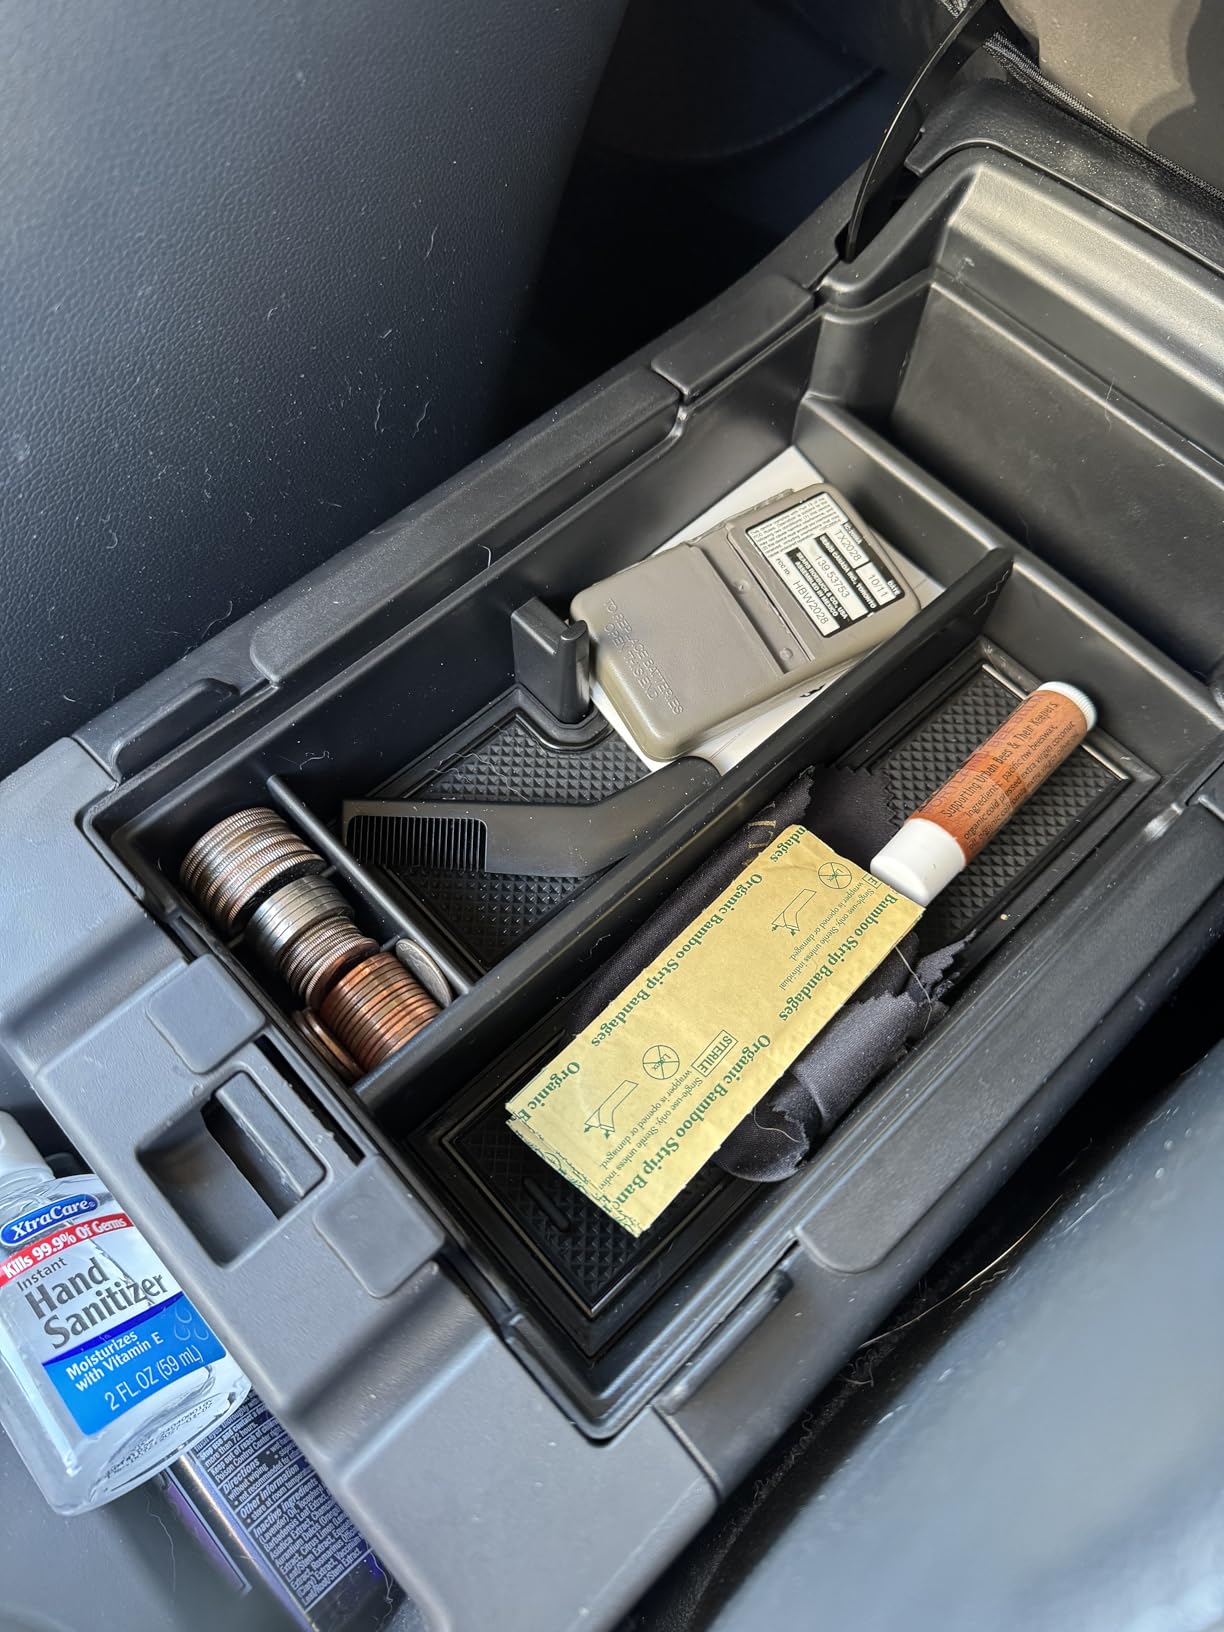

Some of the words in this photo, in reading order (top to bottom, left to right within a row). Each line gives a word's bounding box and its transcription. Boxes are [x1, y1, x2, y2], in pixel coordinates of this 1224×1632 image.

[834, 529, 861, 561] TX2028
[794, 561, 819, 590] ASSEMBLED
[816, 589, 824, 597] IN
[820, 595, 838, 616] MEXICO
[796, 551, 811, 569] SEARS
[808, 567, 828, 593] ROEBUCK
[837, 606, 847, 619] USA
[815, 555, 850, 597] 139.53753
[819, 535, 834, 552] SEARS
[831, 551, 850, 572] CANADA
[855, 582, 876, 608] TORONTO
[868, 574, 888, 597] 10/11
[886, 580, 900, 595] DATE
[792, 580, 829, 624] HBW2028
[602, 622, 629, 651] OPEN
[635, 674, 661, 701] END
[609, 610, 650, 661] REPLACE
[641, 656, 686, 717] BATTERIES
[940, 781, 982, 821] Supporting
[974, 762, 999, 782] Urban
[992, 748, 1013, 764] Bees
[1006, 740, 1020, 749] &
[1013, 724, 1034, 741] Their
[1029, 701, 1058, 726] Keepers
[963, 813, 987, 842] organic
[985, 798, 1000, 816] cold
[998, 775, 1023, 804] pressed
[1020, 762, 1037, 779] extra
[1035, 744, 1055, 763] virgin
[1051, 720, 1075, 746] coconut
[1001, 758, 1023, 782] pacific
[718, 871, 762, 916] Organic
[842, 881, 863, 903] wrapper
[846, 888, 874, 914] Single-use
[675, 913, 723, 961] Bamboo
[819, 907, 839, 929] opened
[819, 926, 839, 944] Sterile
[835, 913, 848, 926] only.
[854, 893, 898, 937] Bamboo
[788, 933, 815, 961] damaged.
[803, 943, 821, 962] unless
[826, 934, 858, 966] Strip
[645, 958, 679, 990] Strip
[776, 964, 833, 1022] Bandages
[778, 960, 807, 990] individual
[589, 988, 650, 1049] Bandages
[696, 1035, 732, 1073] STERILE
[721, 1031, 771, 1086] Organic
[527, 1058, 580, 1112] Organic
[665, 1069, 692, 1096] wrapper
[670, 1076, 703, 1110] Single-use
[630, 1127, 638, 1136] or
[636, 1102, 661, 1129] opened
[654, 1110, 671, 1126] only.
[675, 1082, 728, 1139] Bamboo
[599, 1135, 631, 1170] damaged.
[615, 1147, 637, 1170] unless
[635, 1126, 658, 1148] Sterile
[640, 1136, 679, 1177] Strip
[2, 1255, 33, 1278] Kills
[32, 1231, 77, 1260] 99.9%
[75, 1224, 93, 1239] Of
[91, 1218, 127, 1233] Germs
[17, 1256, 68, 1291] Instant
[24, 1256, 110, 1320] Hand
[43, 1273, 168, 1349] Sanitizer
[65, 1331, 138, 1380] Moisturizes
[75, 1368, 105, 1392] with
[101, 1338, 152, 1371] Vitamin
[151, 1331, 164, 1345] E
[104, 1391, 120, 1411] 2
[135, 1366, 159, 1390] OZ
[156, 1355, 180, 1381] (59
[179, 1345, 204, 1367] mL)
[199, 1446, 213, 1460] Stop
[211, 1438, 223, 1449] use
[221, 1427, 233, 1441] and
[232, 1412, 253, 1432] contact
[204, 1451, 220, 1467] more
[217, 1440, 233, 1454] than
[230, 1432, 241, 1443] 72
[238, 1421, 258, 1437] hours.
[210, 1460, 225, 1477] Keep
[223, 1452, 235, 1464] out
[233, 1445, 241, 1455] of
[239, 1432, 256, 1450] reach
[214, 1463, 235, 1483] Poison
[232, 1445, 254, 1466] Control
[252, 1433, 271, 1449] Center
[220, 1455, 259, 1494] Directions
[227, 1478, 250, 1500] without
[247, 1463, 268, 1481] wiping
[238, 1490, 249, 1502] not
[247, 1460, 283, 1494] recommended
[239, 1495, 260, 1518] Other
[259, 1463, 299, 1500] information
[251, 1504, 266, 1520] store
[265, 1497, 273, 1507] at
[271, 1486, 287, 1501] room
[252, 1507, 282, 1538] Inactive
[280, 1476, 318, 1512] ingredients
[258, 1513, 289, 1546] (Lavender)
[286, 1503, 299, 1517] Oil,
[295, 1483, 323, 1509] Tocopheryl
[263, 1517, 299, 1552] Barbadensis
[295, 1505, 310, 1521] Leaf
[269, 1536, 293, 1560] Asiatica
[289, 1517, 314, 1539] Extract,
[274, 1537, 304, 1567] Aurantium
[301, 1522, 321, 1541] Dulcis
[279, 1552, 303, 1575] Extract,
[299, 1536, 319, 1555] Citrus
[315, 1522, 335, 1540] Limon
[284, 1553, 315, 1582] Leaf/Stem
[311, 1534, 335, 1556] Extract,
[289, 1566, 314, 1590] Extract,
[310, 1538, 344, 1570] Rosmarinus
[296, 1575, 316, 1598] (Clary)
[313, 1557, 338, 1580] Extract,
[301, 1562, 344, 1606] Leaf/Root/Stem
[340, 1546, 362, 1567] Extract.
